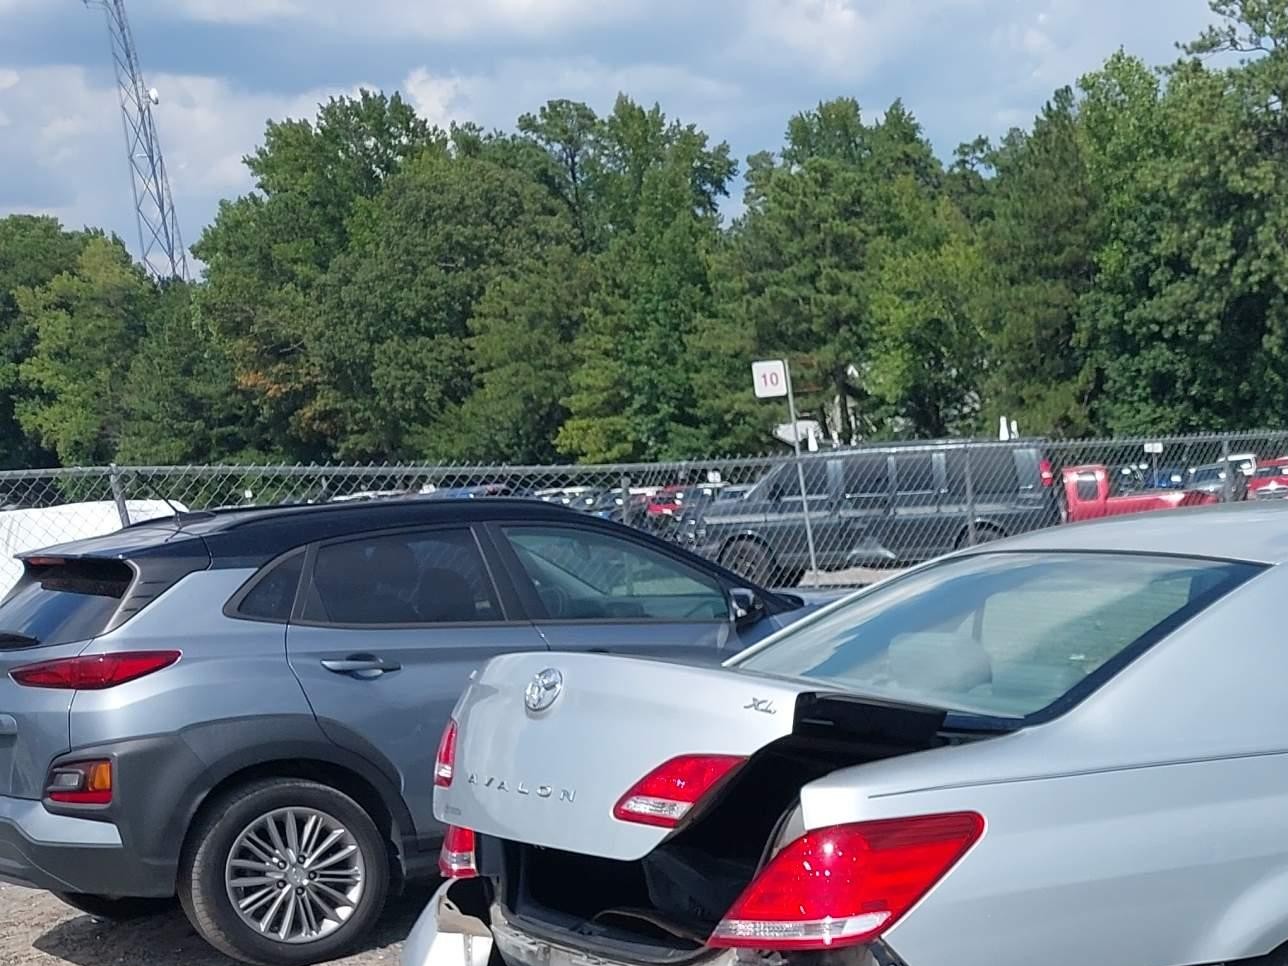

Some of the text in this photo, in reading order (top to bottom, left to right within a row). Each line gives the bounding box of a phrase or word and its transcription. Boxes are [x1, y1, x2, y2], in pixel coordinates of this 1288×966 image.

[761, 372, 779, 387] 10
[743, 697, 777, 715] XL
[467, 773, 577, 803] AVALON
